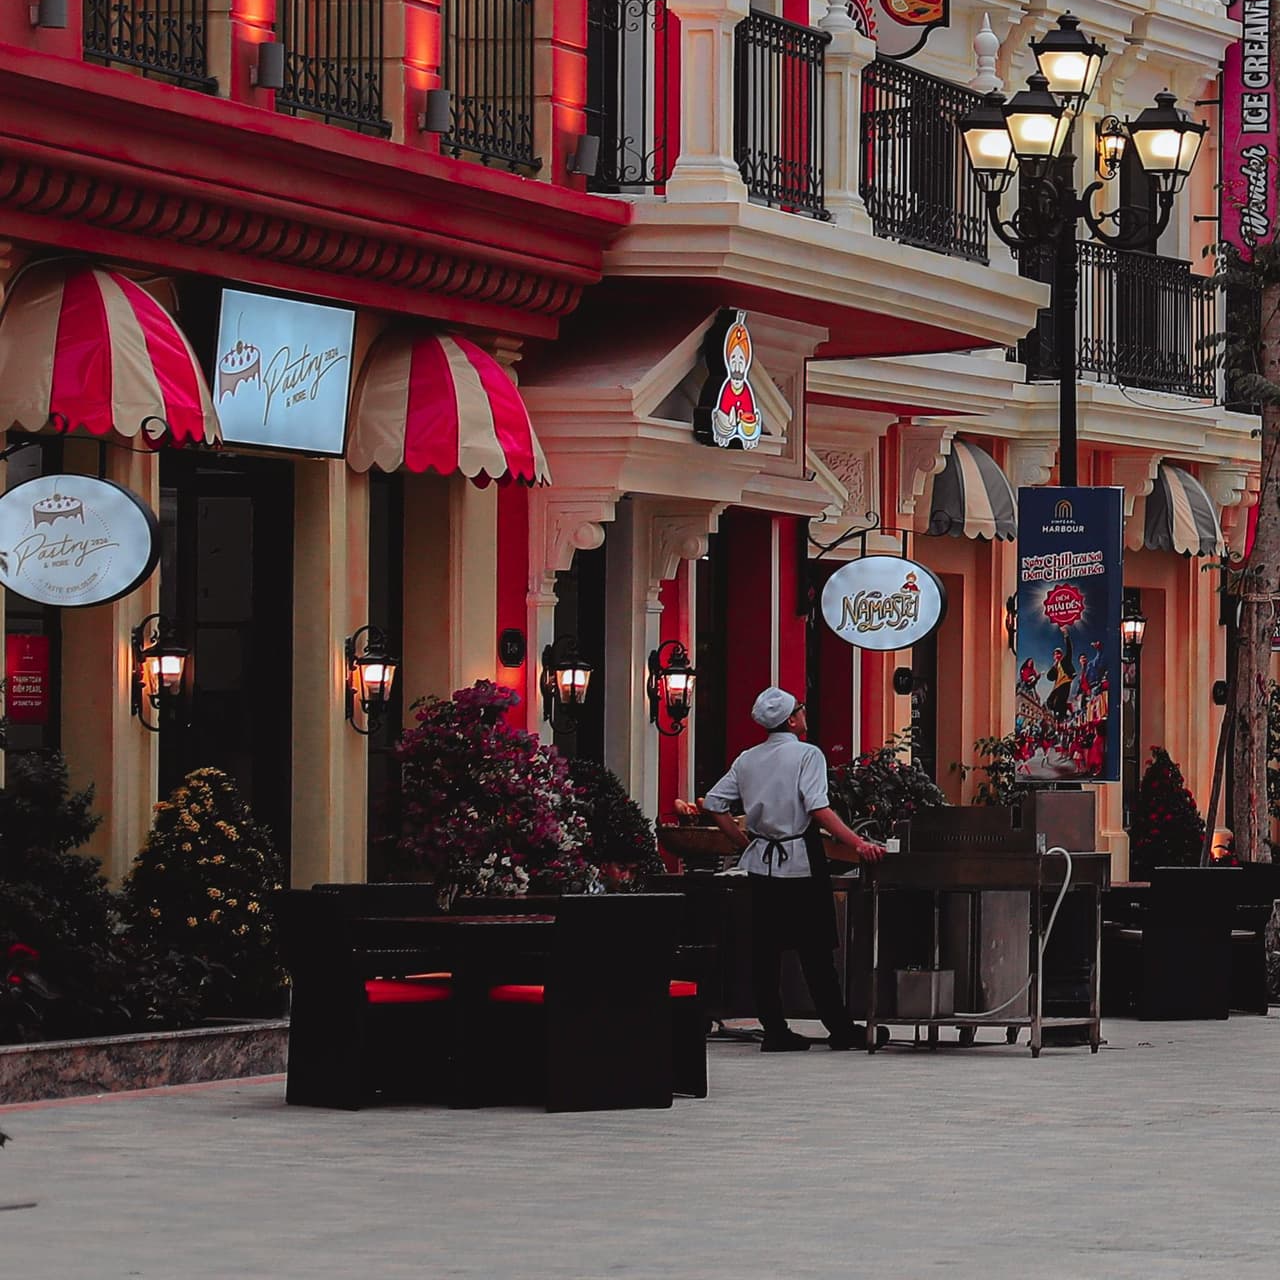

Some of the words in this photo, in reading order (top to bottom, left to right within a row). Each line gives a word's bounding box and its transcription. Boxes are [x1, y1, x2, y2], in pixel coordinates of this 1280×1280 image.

[1241, 92, 1270, 135] ICE
[1240, 144, 1269, 249] Wonder
[263, 343, 348, 426] Pastry
[1041, 525, 1085, 533] HARBOUR
[13, 532, 120, 577] Pastry
[1044, 552, 1072, 568] Chill
